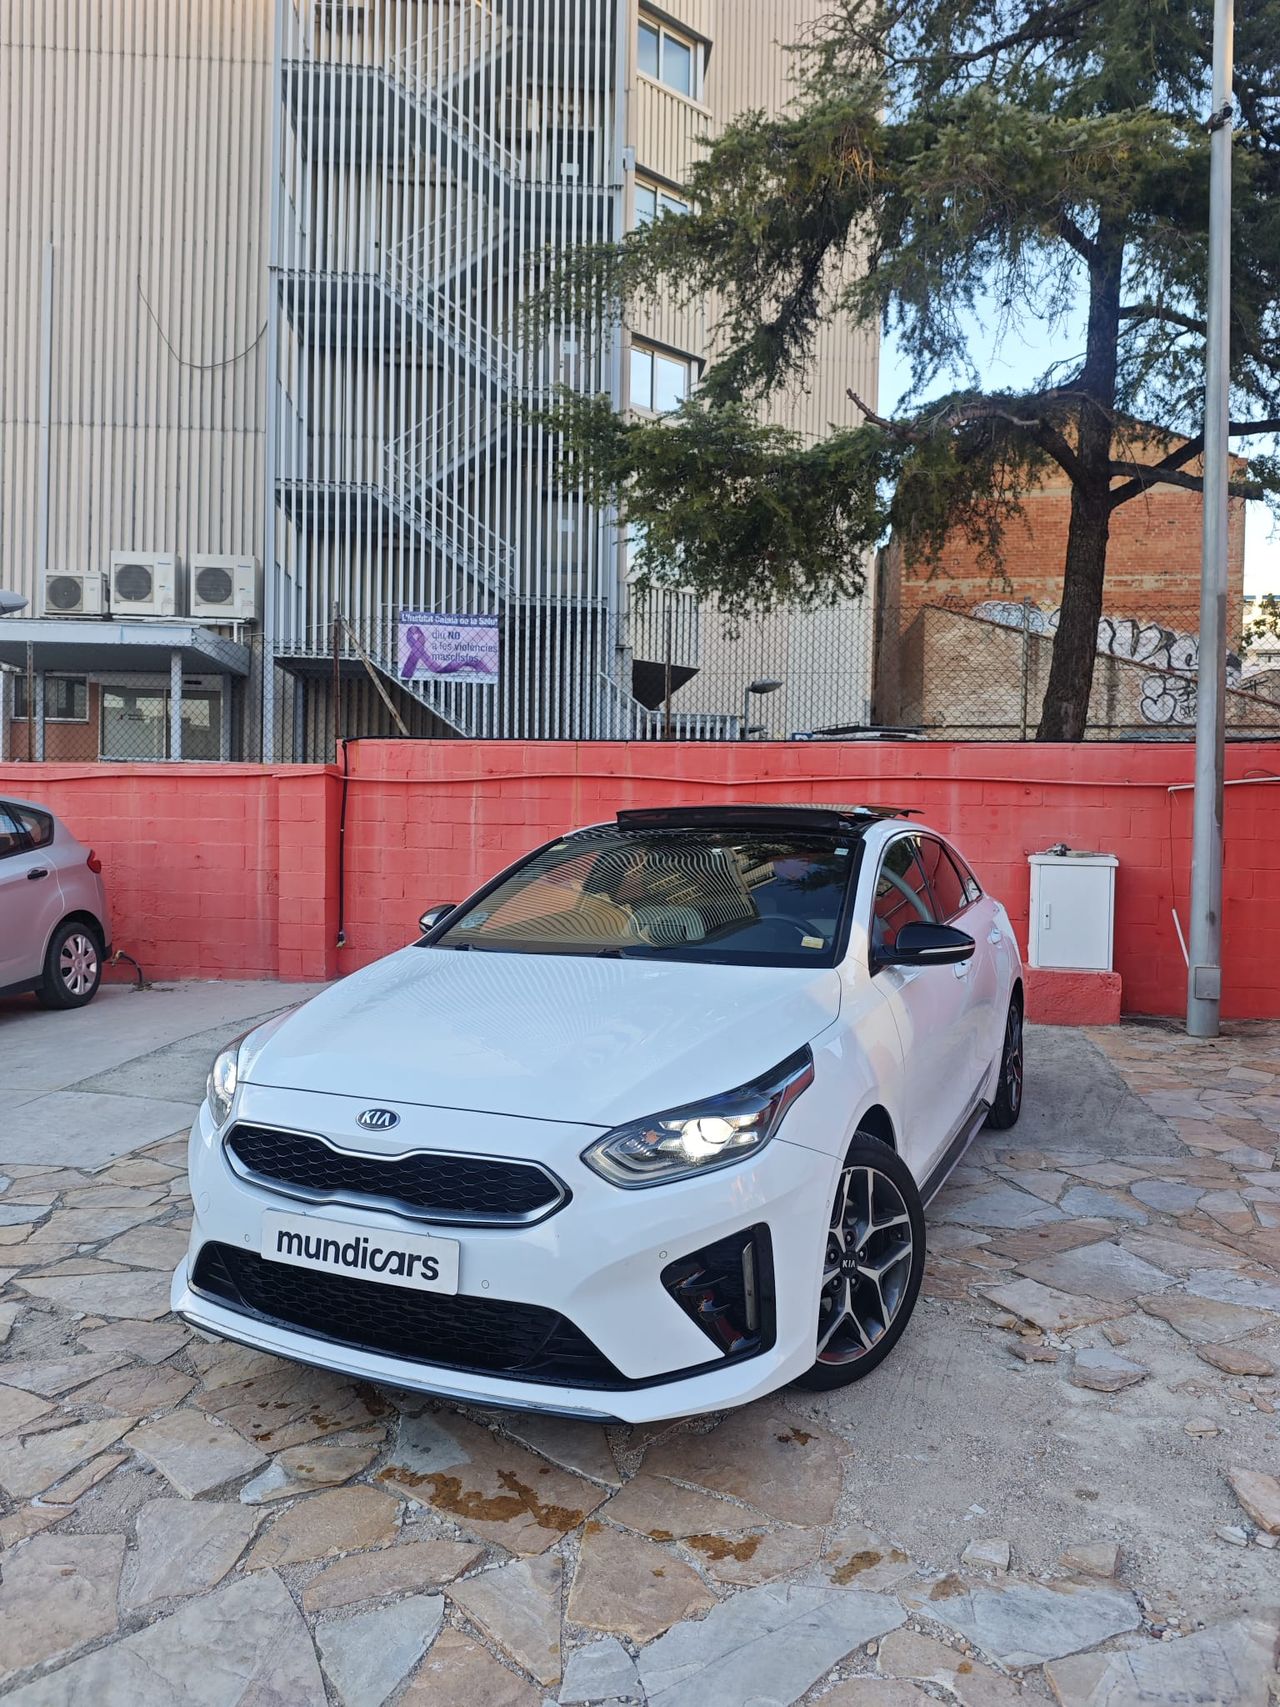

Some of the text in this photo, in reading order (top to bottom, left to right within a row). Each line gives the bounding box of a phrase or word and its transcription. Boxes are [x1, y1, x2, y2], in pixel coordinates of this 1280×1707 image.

[447, 631, 461, 640] NO
[360, 1110, 391, 1126] KIA
[276, 1230, 440, 1281] mundicars
[842, 1259, 856, 1269] KIA
